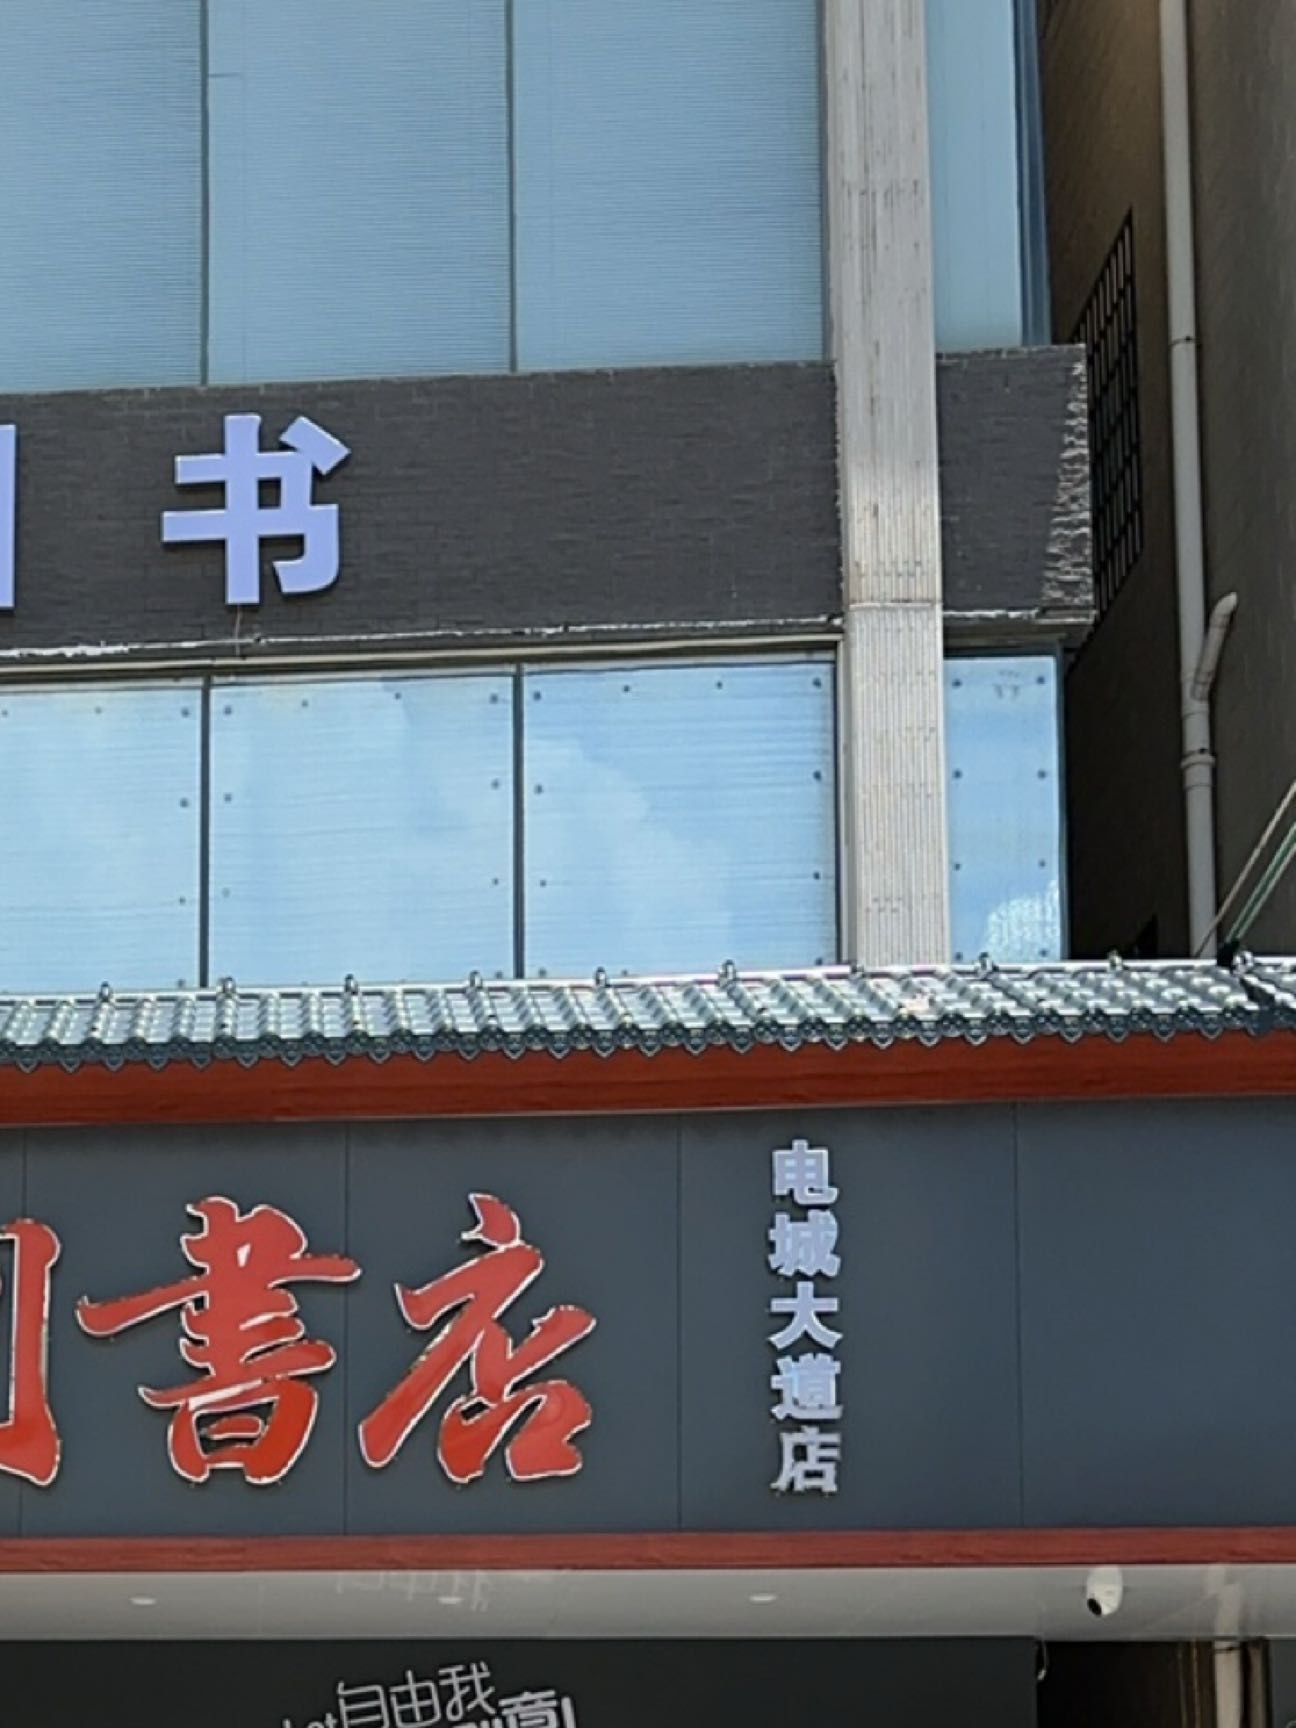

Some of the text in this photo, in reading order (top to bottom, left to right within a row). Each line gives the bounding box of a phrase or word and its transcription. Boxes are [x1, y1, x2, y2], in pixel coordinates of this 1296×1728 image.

[768, 1139, 844, 1493] 电城大道店
